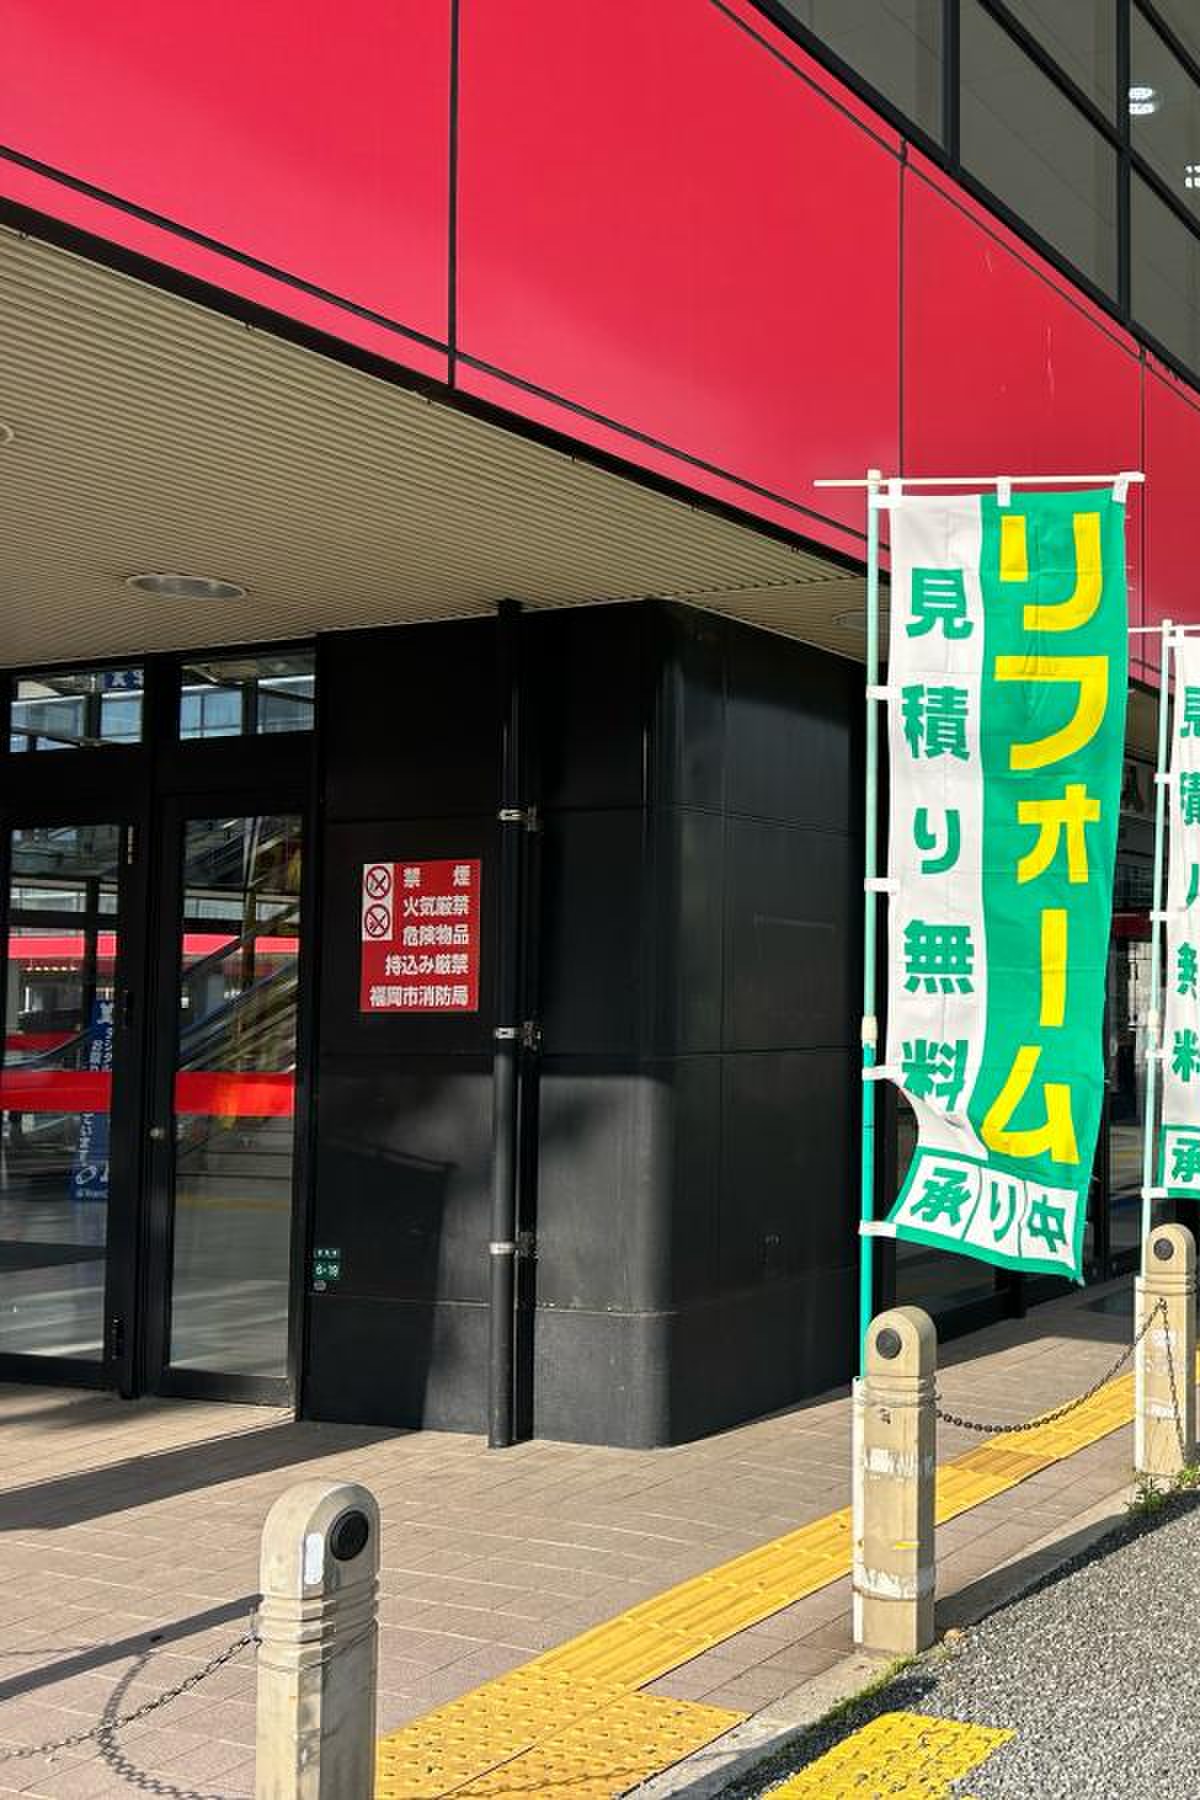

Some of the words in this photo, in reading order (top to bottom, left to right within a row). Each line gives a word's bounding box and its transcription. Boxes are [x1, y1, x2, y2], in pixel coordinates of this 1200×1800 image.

[900, 567, 975, 1117] 見積り無料
[981, 511, 1109, 1166] リフォーム
[402, 895, 470, 917] 火気厳禁
[402, 923, 470, 946] 危険物品
[384, 953, 470, 976] 持込み厳禁
[369, 985, 469, 1008] 福岡市消防局
[910, 1167, 1070, 1254] 承り中
